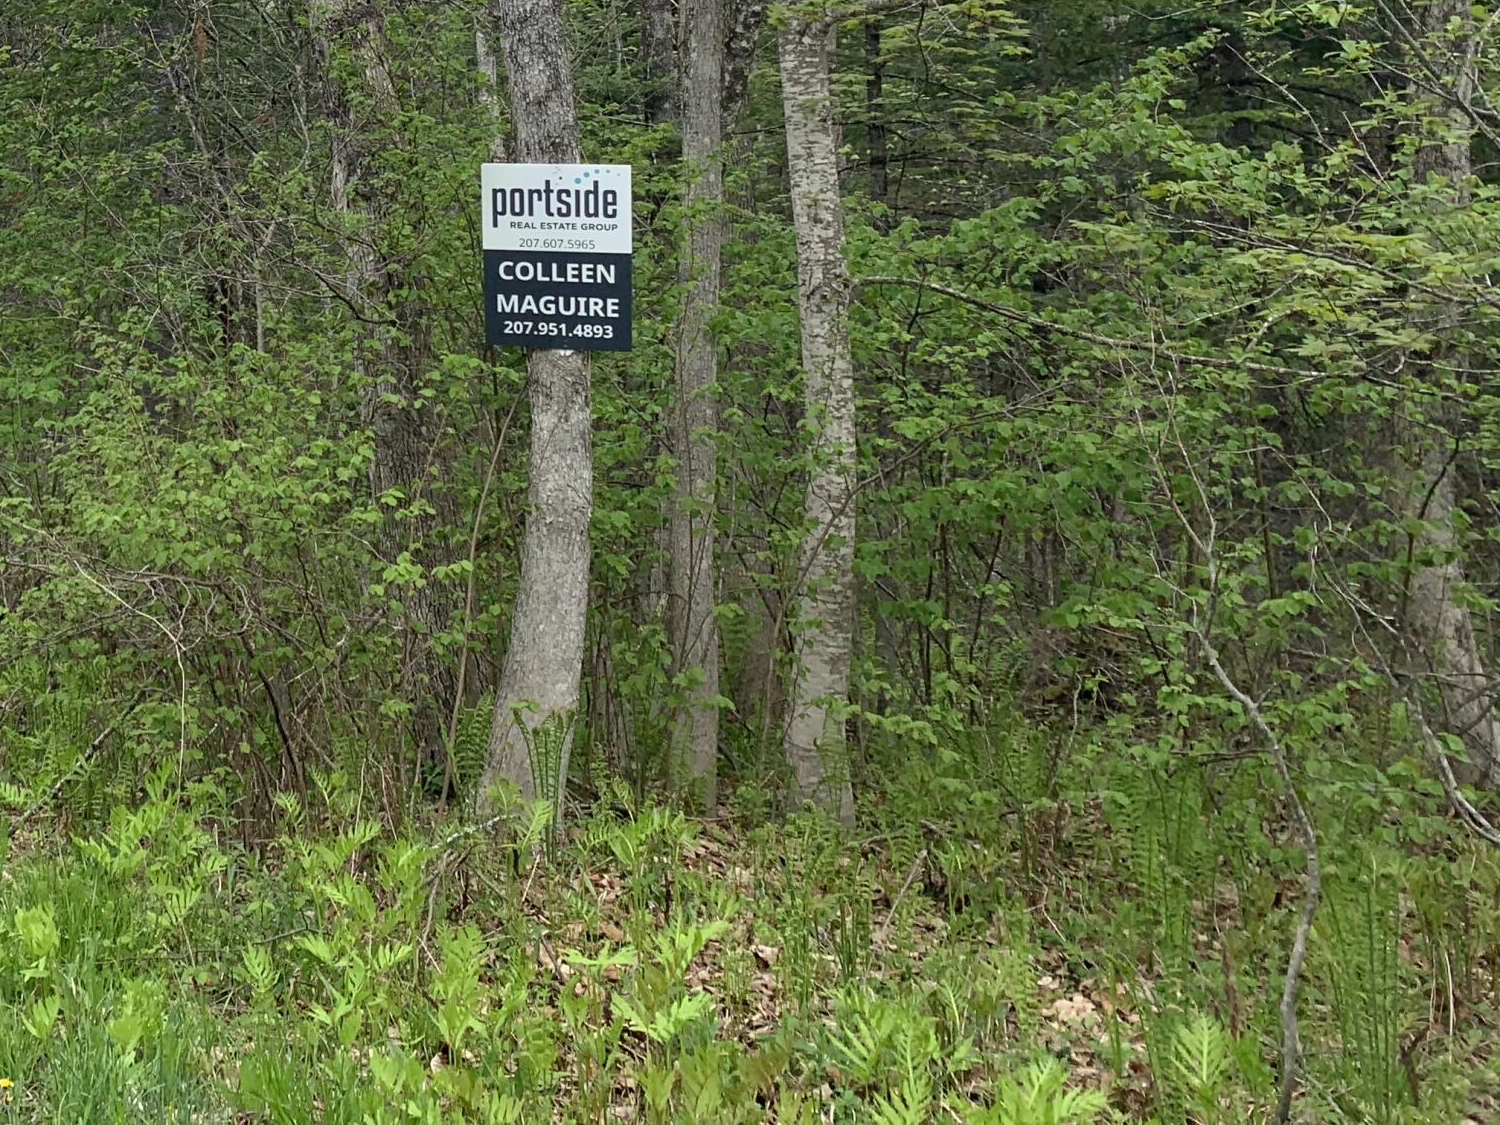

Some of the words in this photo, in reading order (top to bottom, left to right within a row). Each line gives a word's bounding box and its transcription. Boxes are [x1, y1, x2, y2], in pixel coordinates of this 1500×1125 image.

[491, 179, 618, 228] portside
[510, 221, 537, 230] REAL
[540, 222, 577, 231] ESTATE
[580, 223, 618, 231] GROUP
[519, 237, 596, 250] 207.607.5965
[498, 261, 616, 284] COLLEEN
[496, 293, 620, 318] MAGUIRE
[503, 321, 614, 339] 207.951.4893
